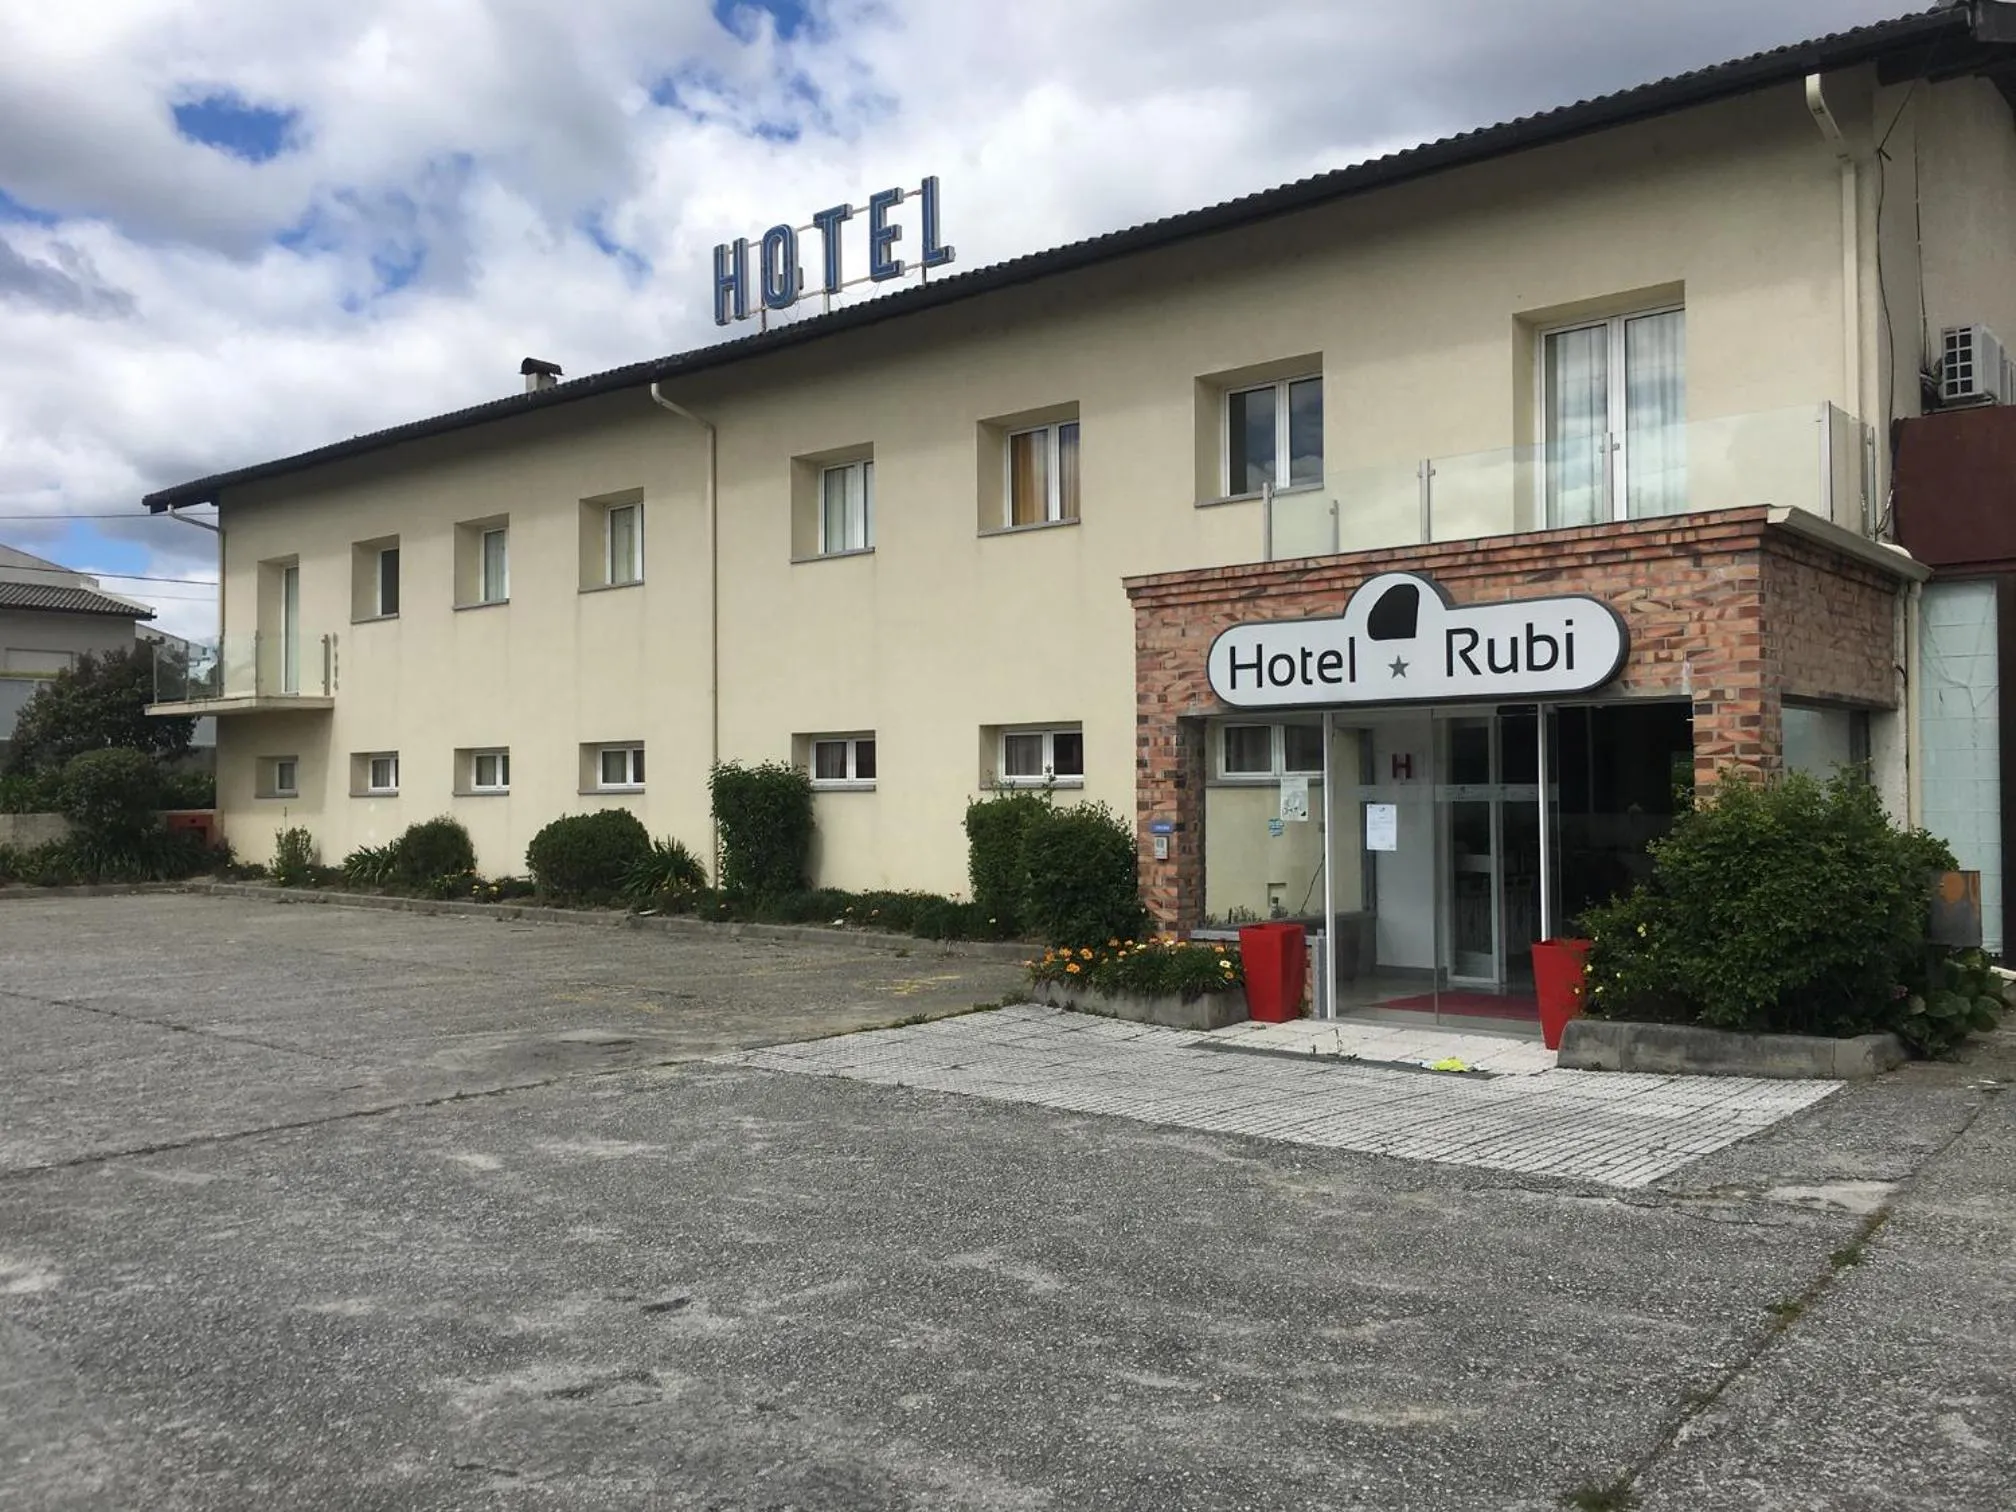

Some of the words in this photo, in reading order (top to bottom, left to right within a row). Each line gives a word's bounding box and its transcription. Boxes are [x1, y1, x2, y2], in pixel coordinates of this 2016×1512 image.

[714, 176, 955, 325] HOTEL
[1230, 636, 1356, 690] Hotel
[1446, 619, 1575, 678] Rubi
[1392, 753, 1411, 779] H
